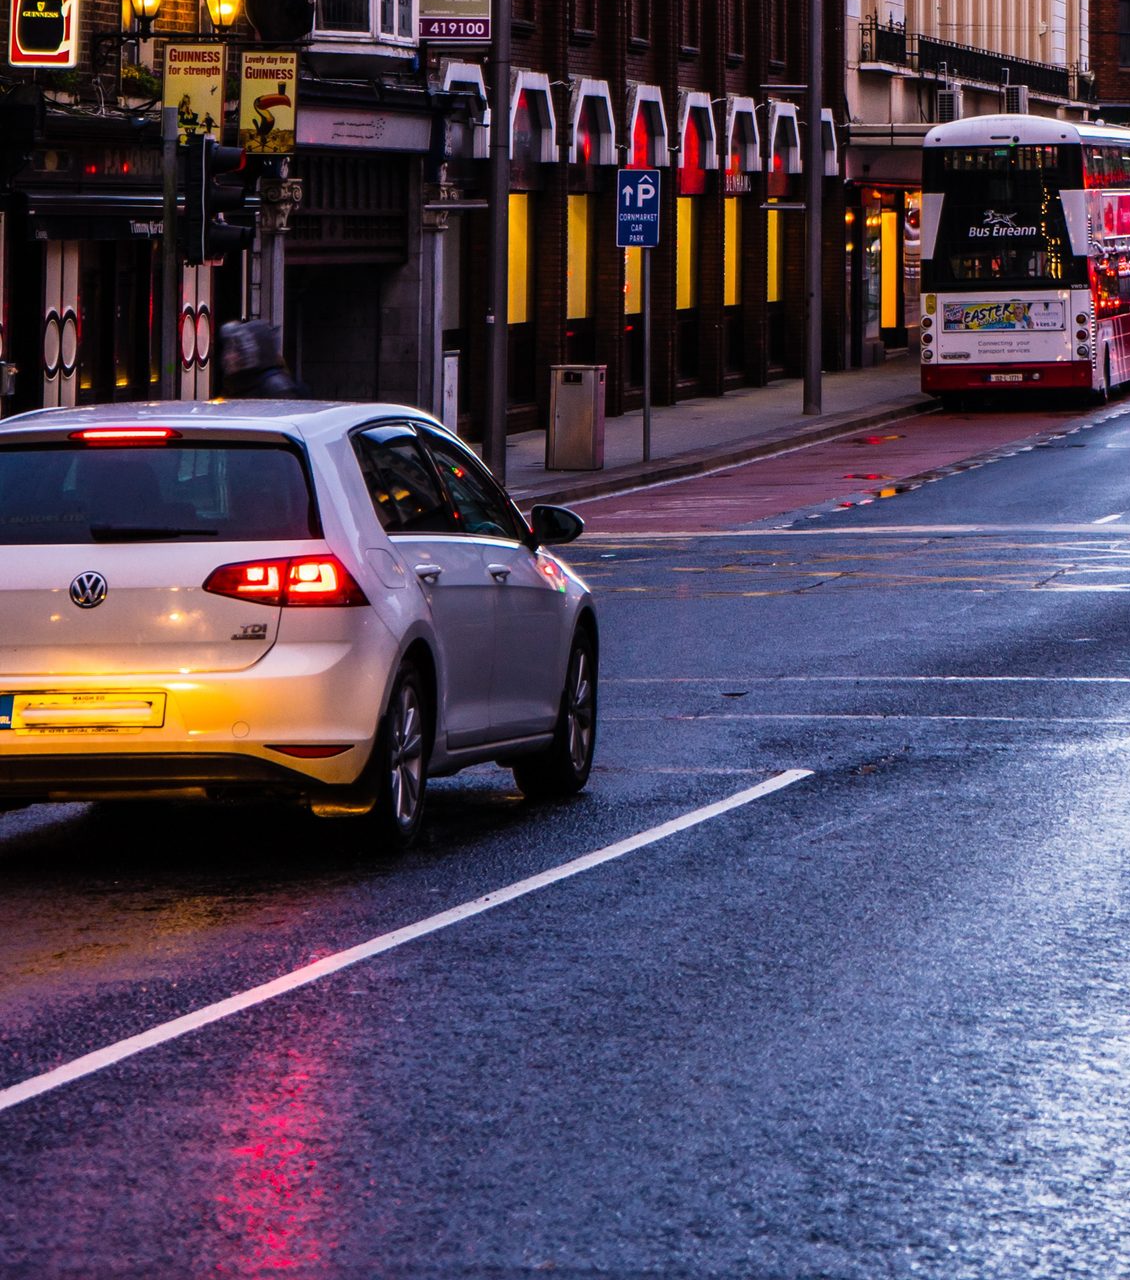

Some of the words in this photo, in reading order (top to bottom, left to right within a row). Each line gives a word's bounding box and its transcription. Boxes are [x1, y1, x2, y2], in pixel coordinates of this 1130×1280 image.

[430, 22, 484, 34] 419100
[169, 48, 220, 63] GUINNESS
[245, 56, 265, 65] Lovely
[266, 56, 278, 65] day
[279, 56, 288, 64] for
[168, 65, 181, 75] for
[184, 65, 220, 77] strength
[245, 66, 293, 80] GUINNESS
[637, 184, 655, 207] P
[619, 213, 657, 221] CORNMARKET
[631, 224, 642, 232] CAR
[969, 227, 990, 237] Bus
[963, 303, 1014, 324] EASTER
[240, 623, 267, 634] TDI
